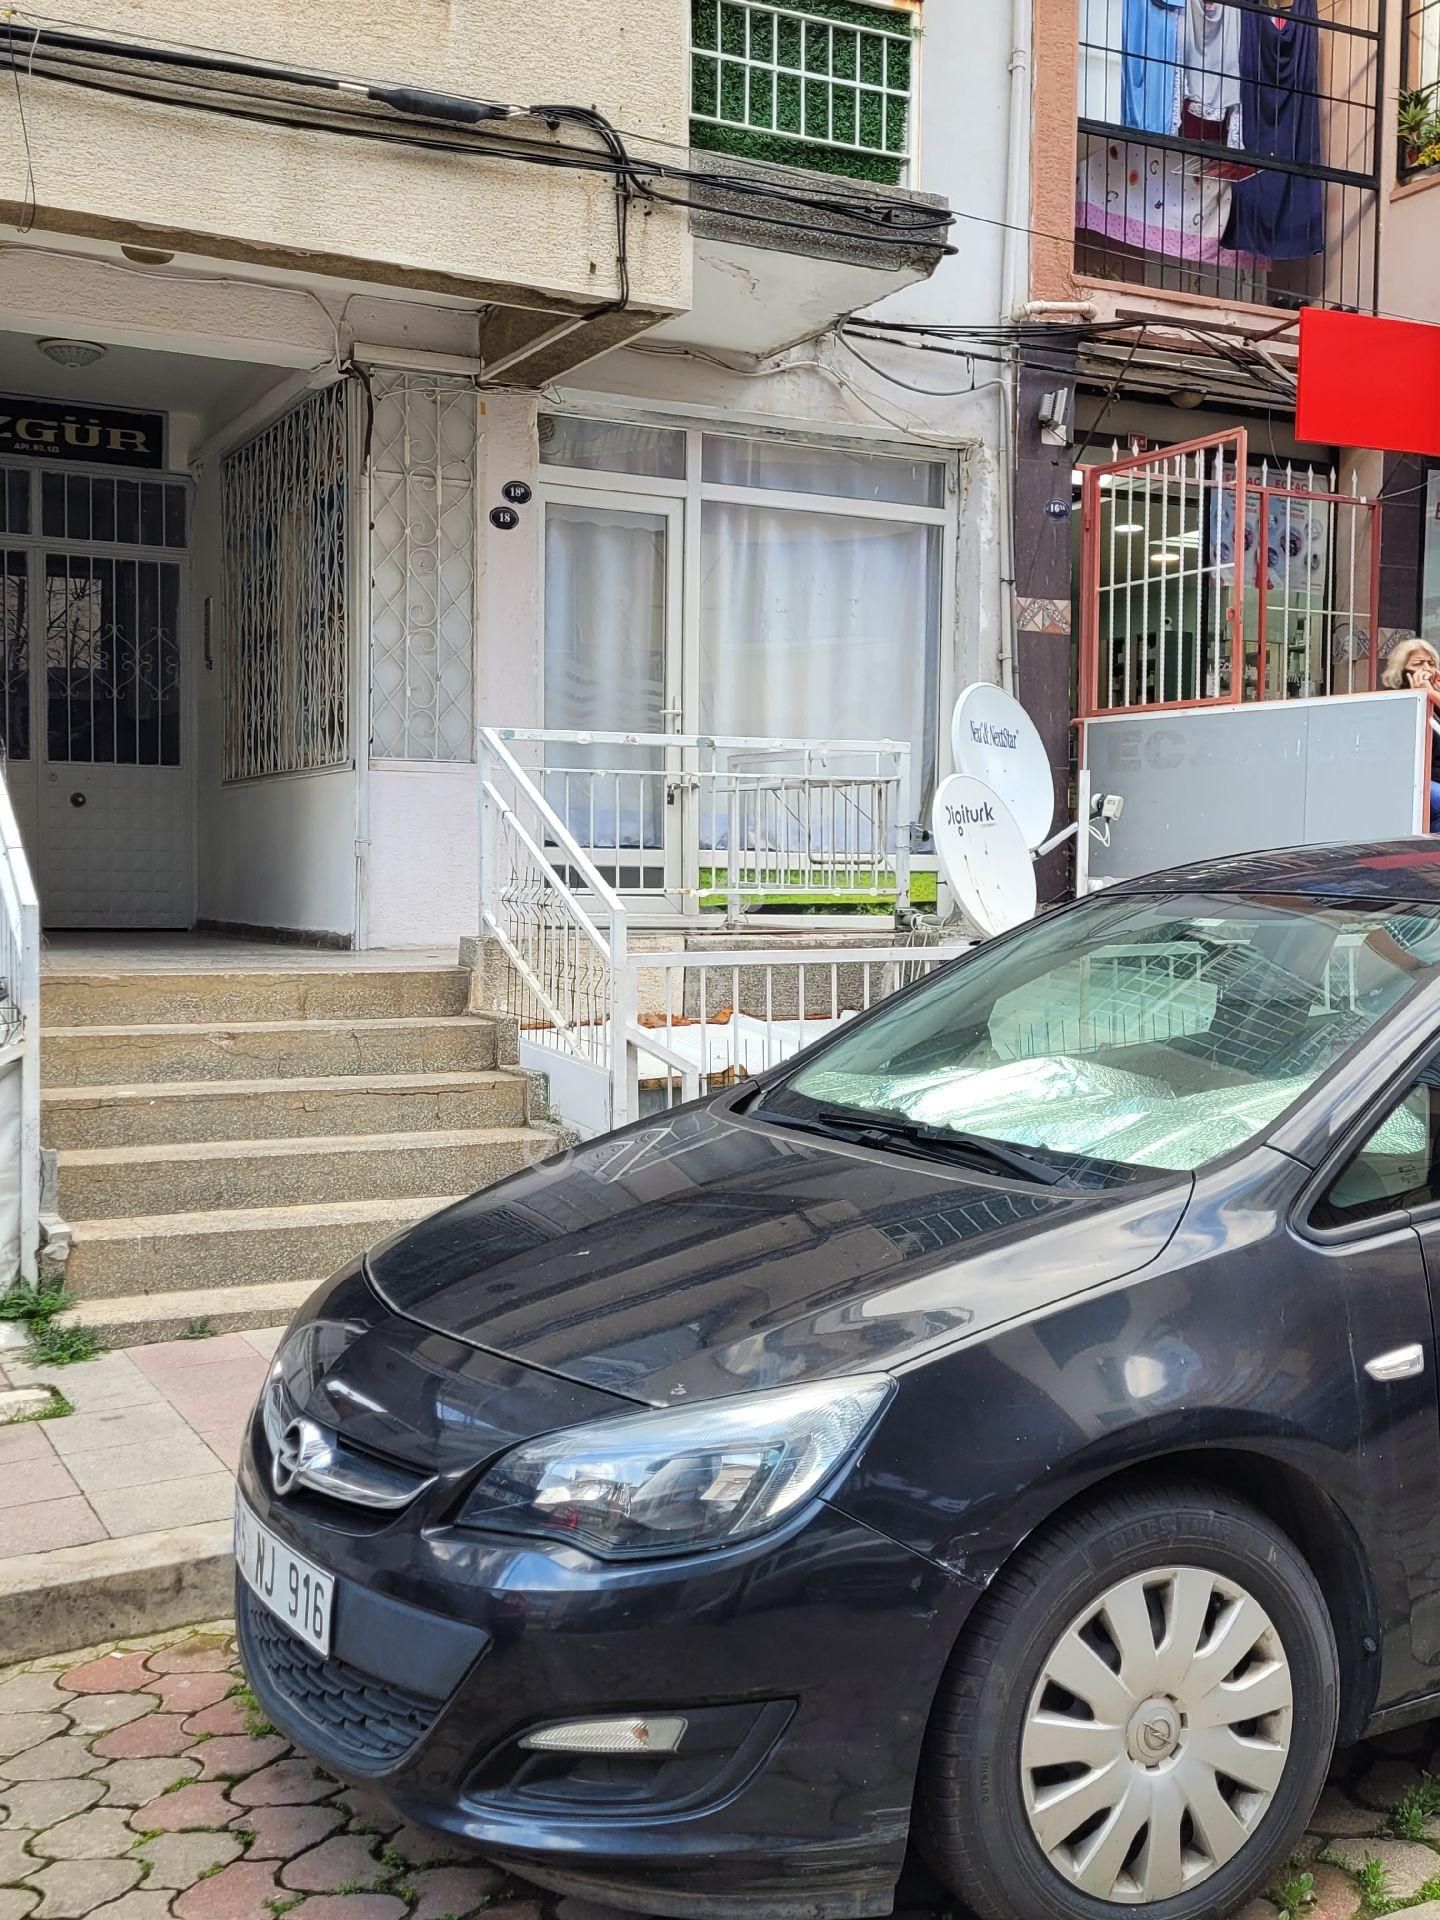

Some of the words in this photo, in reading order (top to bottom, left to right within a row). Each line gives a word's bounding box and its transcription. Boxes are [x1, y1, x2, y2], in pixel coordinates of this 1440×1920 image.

[500, 512, 511, 522] 18
[255, 1530, 276, 1598] NJ
[288, 1561, 325, 1640] 916
